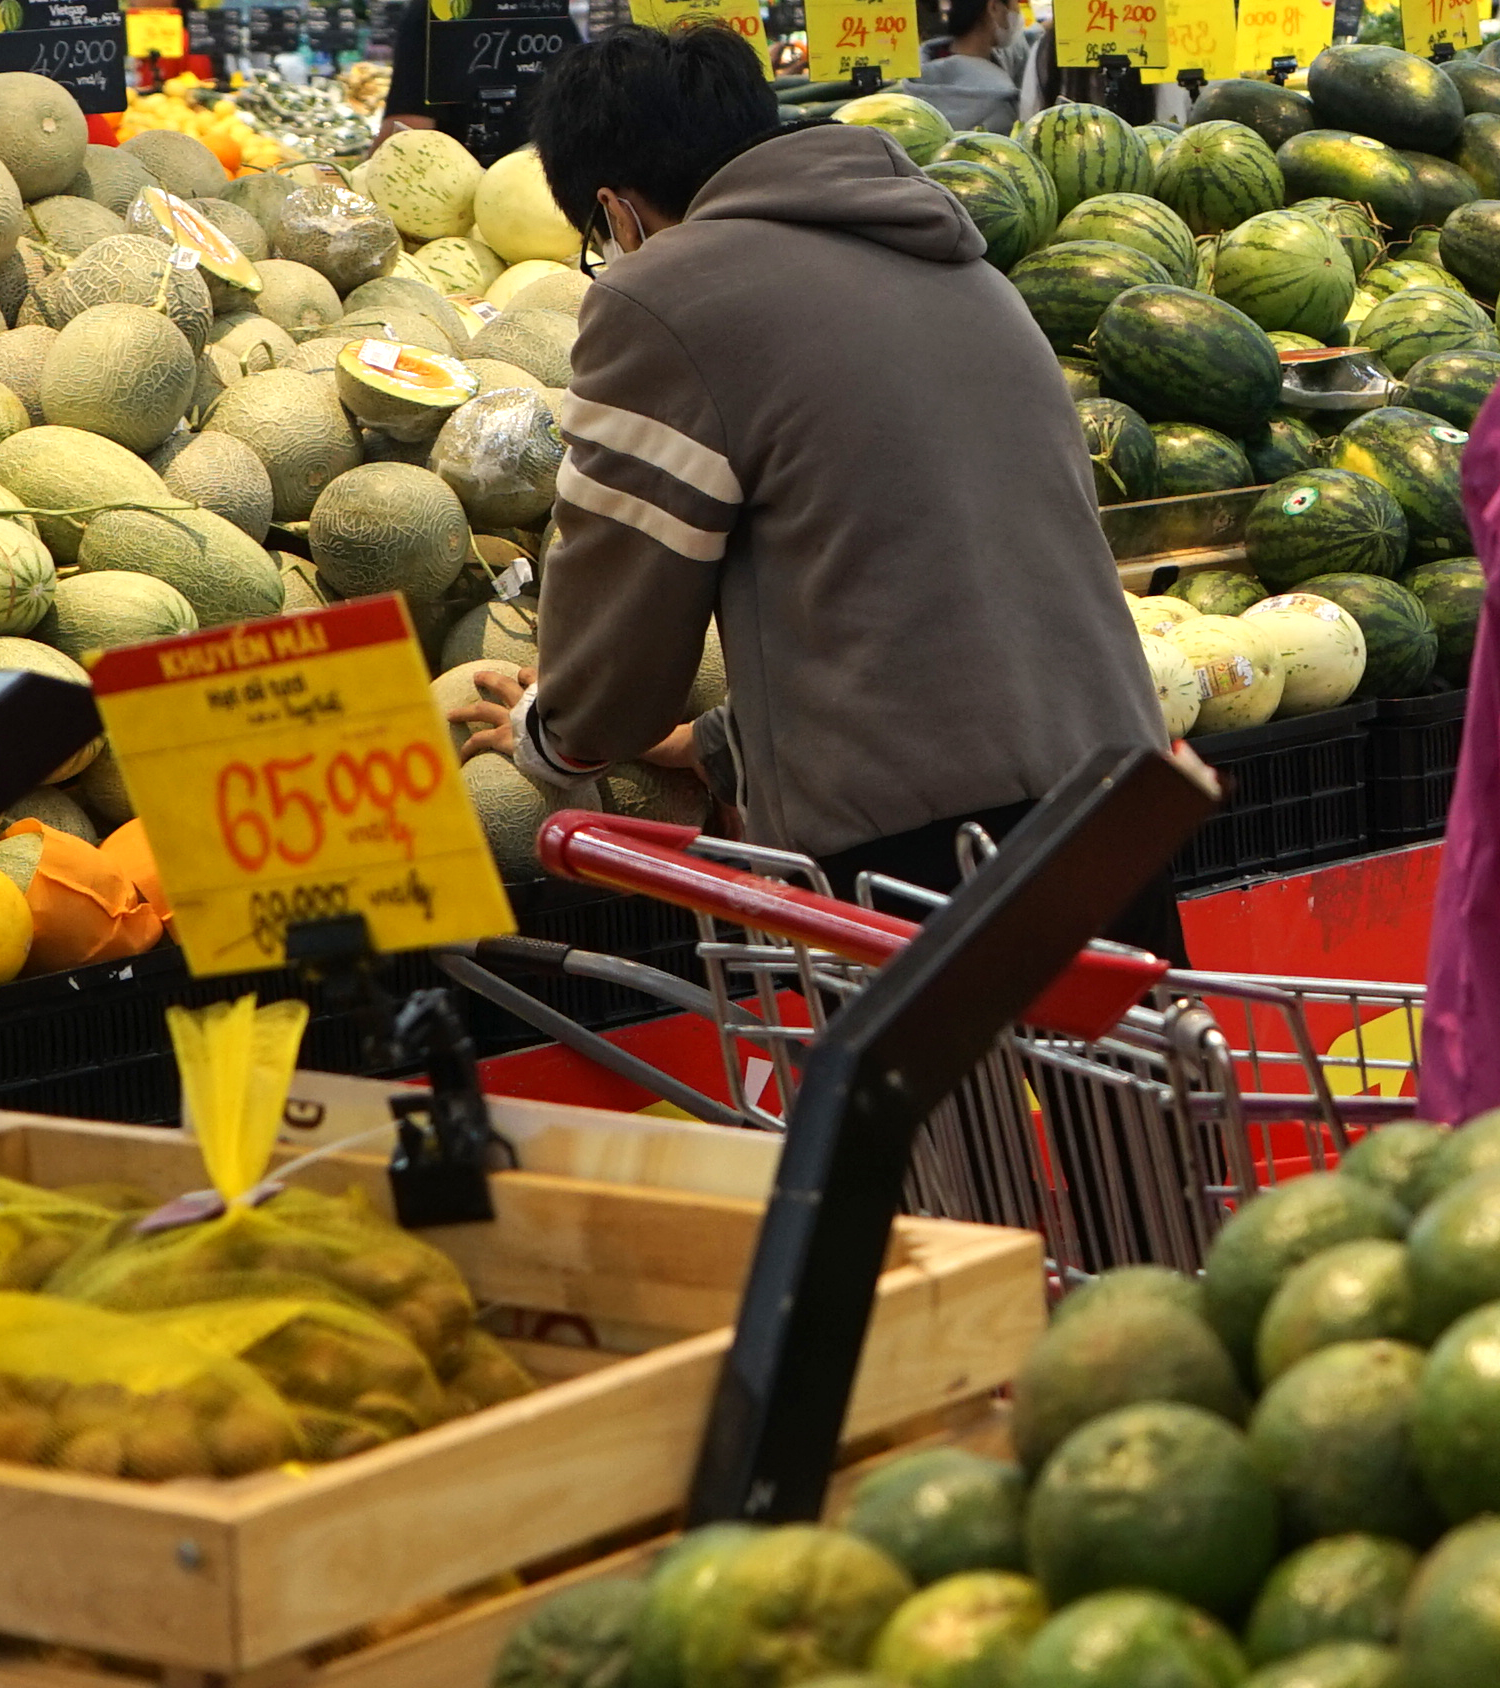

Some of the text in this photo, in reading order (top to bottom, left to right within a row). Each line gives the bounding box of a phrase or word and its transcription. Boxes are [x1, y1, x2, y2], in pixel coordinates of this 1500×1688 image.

[468, 28, 563, 74] 27.000
[157, 618, 329, 679] KHUYẾN MÃI
